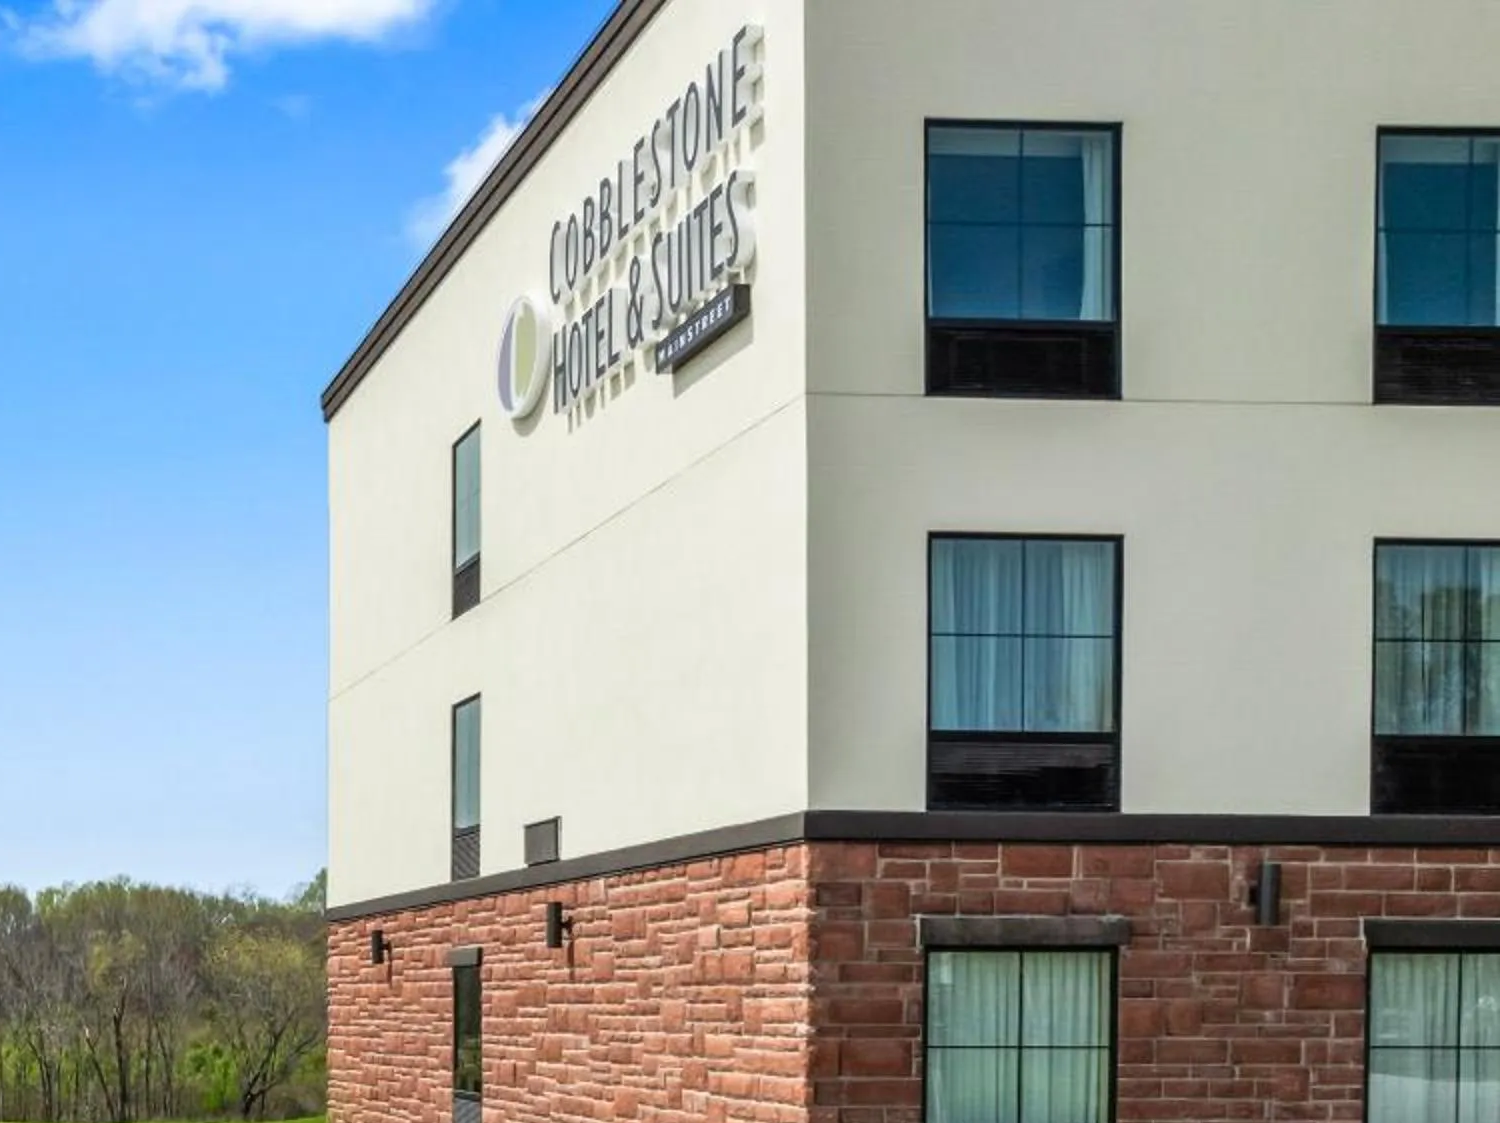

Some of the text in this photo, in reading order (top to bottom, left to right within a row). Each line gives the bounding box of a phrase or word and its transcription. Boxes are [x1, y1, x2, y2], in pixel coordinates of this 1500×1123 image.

[549, 25, 748, 305] COBBLESTONE
[553, 169, 740, 415] HOTEL & SUITES
